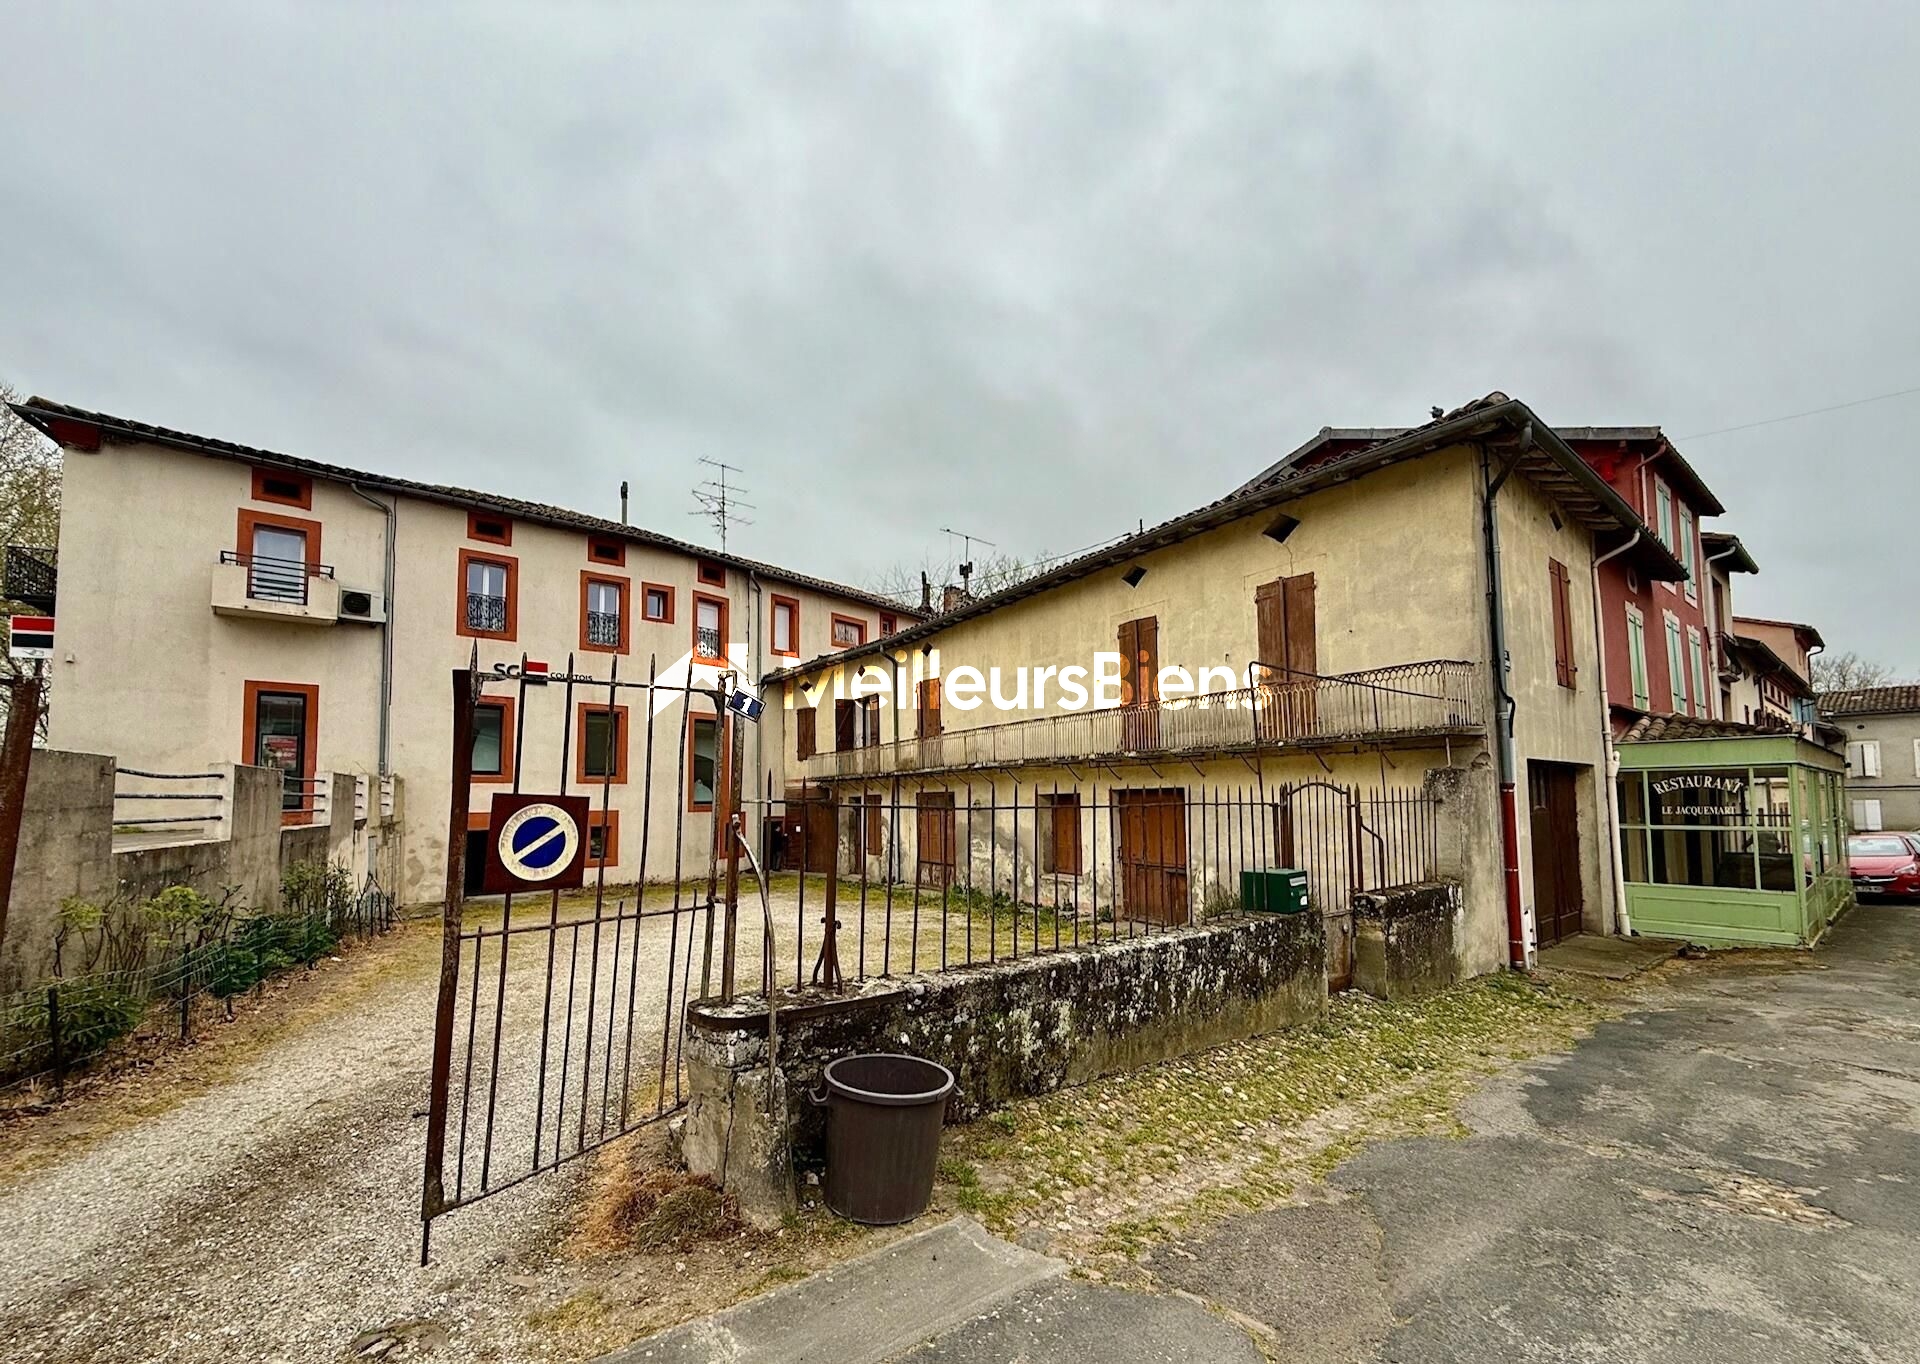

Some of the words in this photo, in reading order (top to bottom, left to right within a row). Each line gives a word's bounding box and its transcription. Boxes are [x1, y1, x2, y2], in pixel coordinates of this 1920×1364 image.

[550, 671, 593, 681] COUTOIS
[740, 697, 753, 714] 1
[1652, 775, 1744, 795] RESTAURANT
[1661, 806, 1673, 815] LE
[1675, 806, 1736, 817] JACQUEMART
